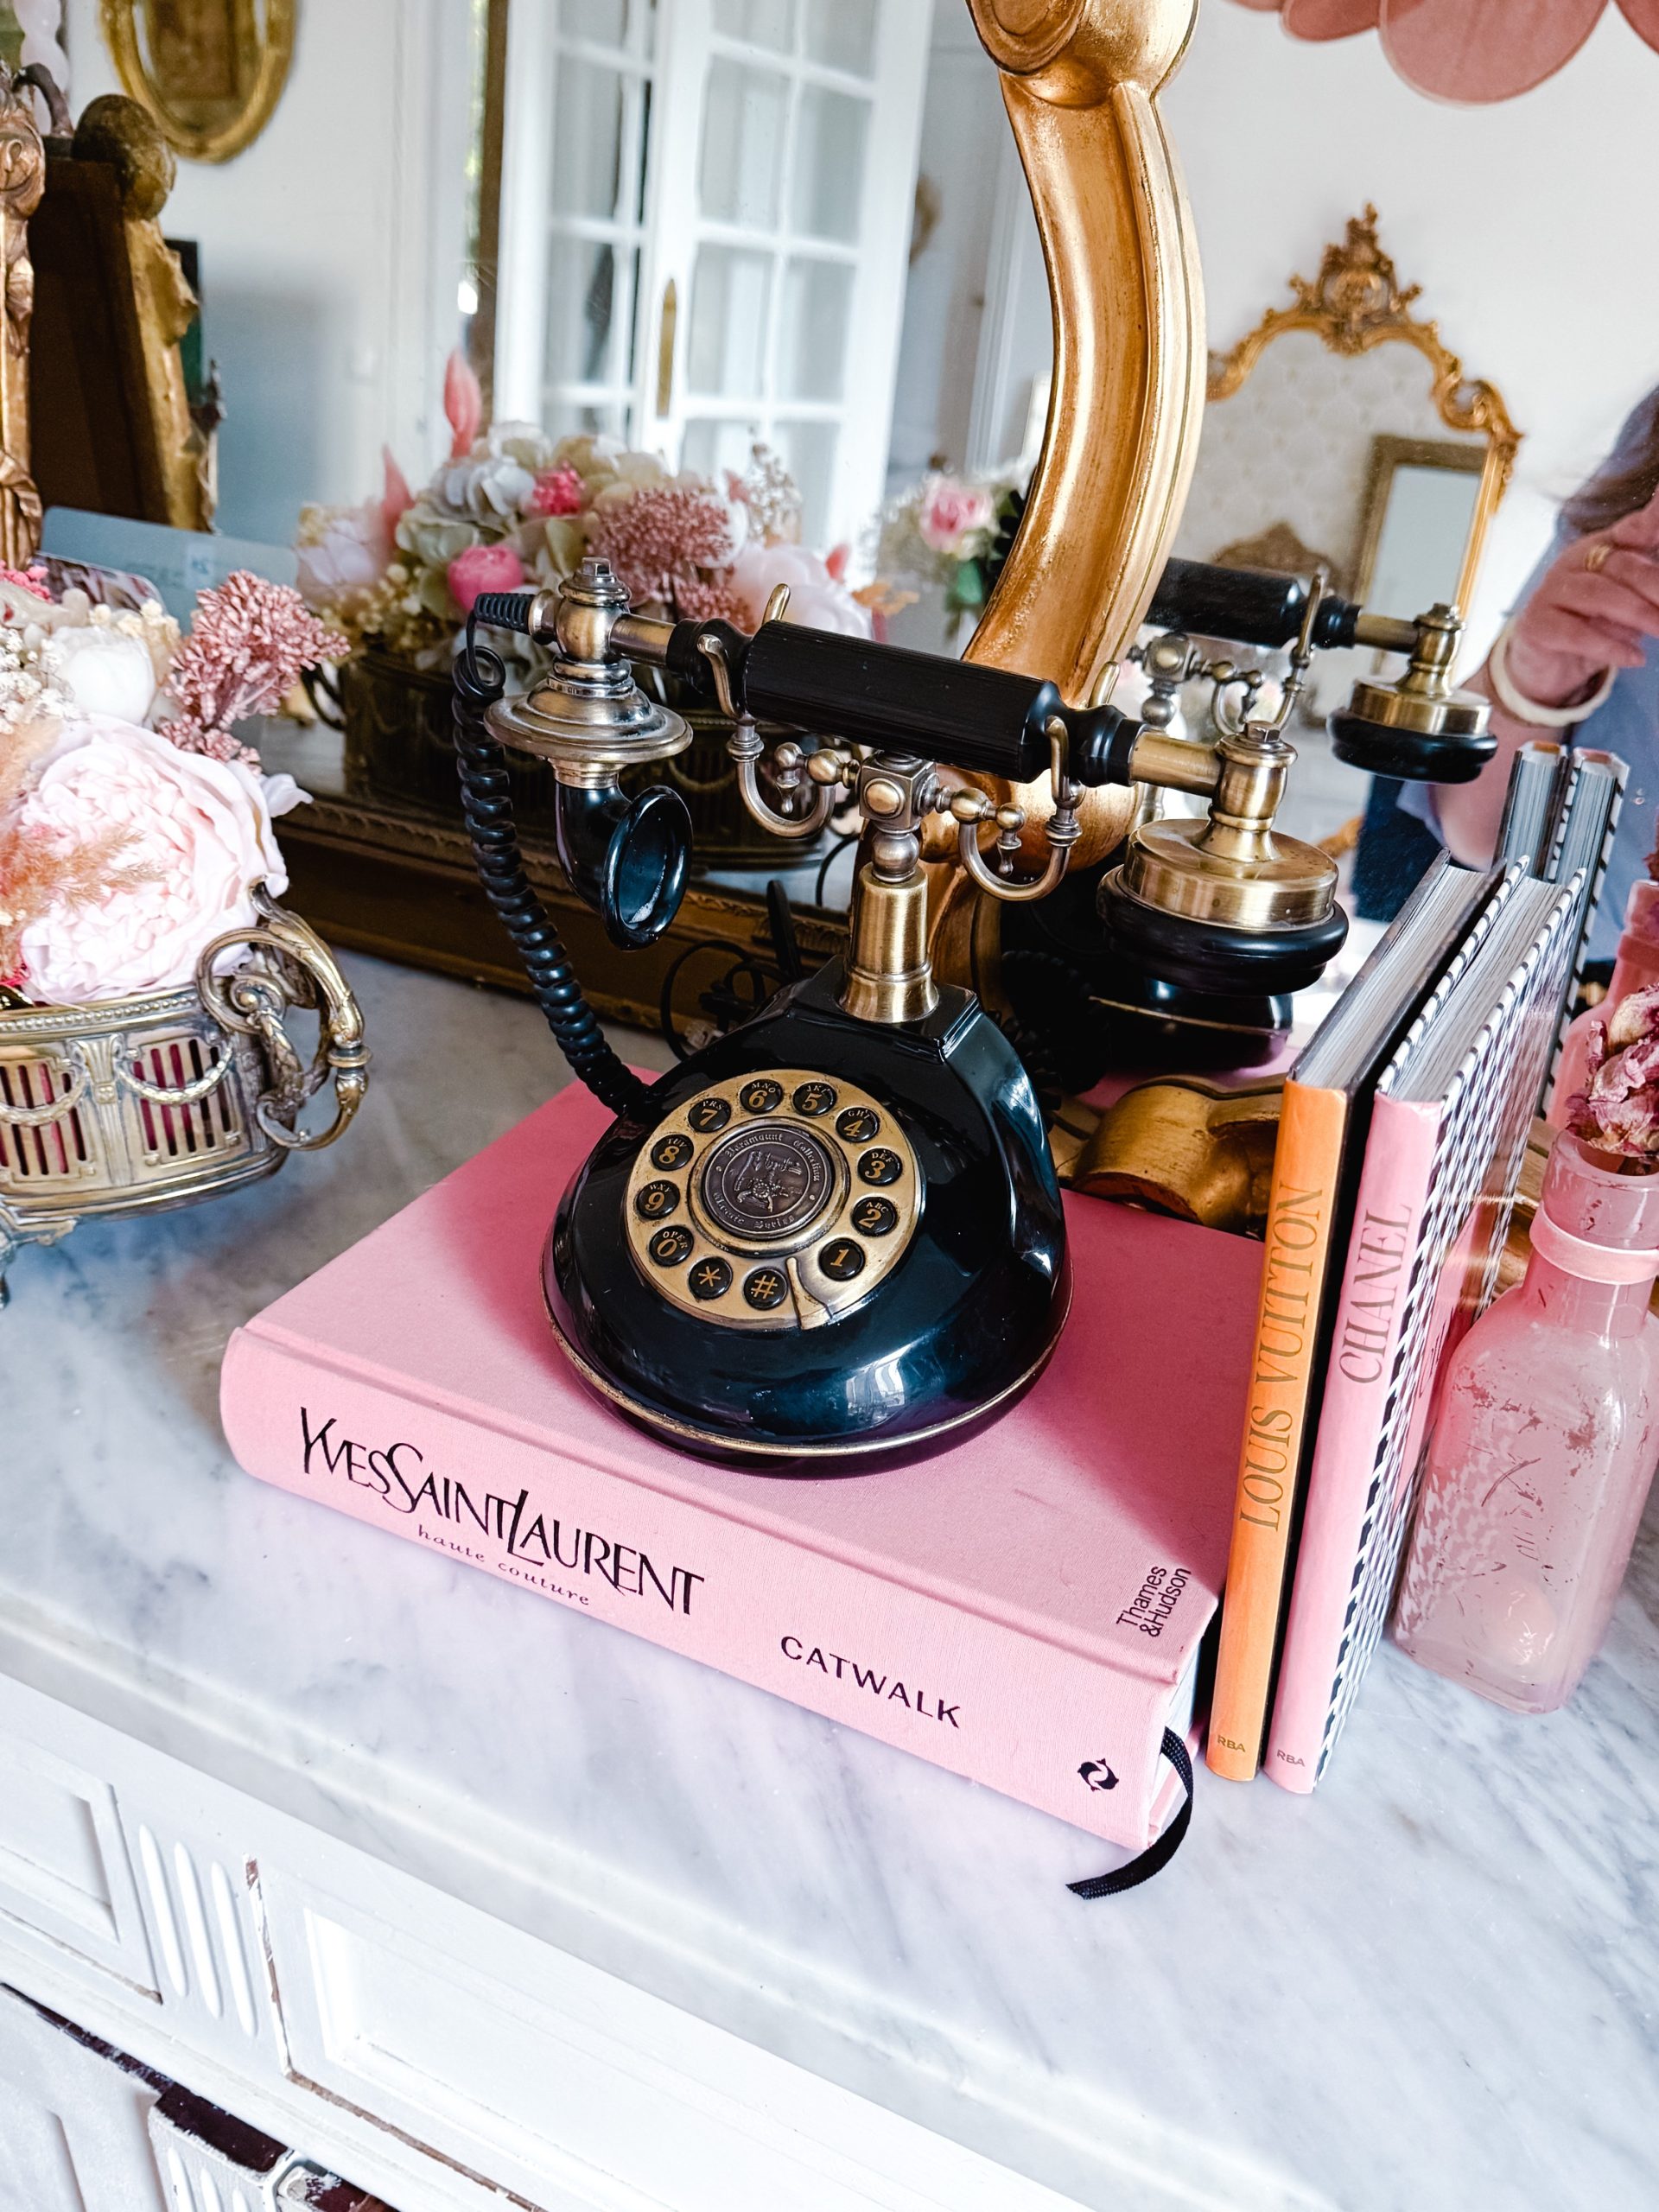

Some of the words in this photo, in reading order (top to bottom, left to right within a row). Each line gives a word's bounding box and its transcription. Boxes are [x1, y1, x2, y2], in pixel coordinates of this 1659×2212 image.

[752, 1082, 776, 1093] MNO
[702, 1100, 724, 1111] PRS
[748, 1090, 768, 1109] 6
[801, 1092, 823, 1111] 5
[699, 1109, 718, 1127] 7
[848, 1109, 871, 1121] GHI
[843, 1120, 864, 1138] 4
[666, 1138, 688, 1148] TUV
[658, 1145, 680, 1165] 8
[871, 1152, 893, 1163] DEF
[864, 1160, 886, 1179] 3
[649, 1183, 672, 1193] WXY
[645, 1192, 664, 1211] 9
[866, 1201, 889, 1213] ABC
[858, 1209, 881, 1229] 2
[662, 1230, 689, 1249] OPER
[830, 1249, 849, 1267] 1
[1255, 1180, 1323, 1384] VUITTON
[1338, 1205, 1414, 1384] CHANEL
[1240, 1405, 1294, 1532] LOUIS
[417, 1523, 486, 1563] haute
[498, 1562, 589, 1606] couture
[1116, 1566, 1167, 1626] Thames
[1140, 1567, 1192, 1637] &Hudson
[780, 1635, 962, 1729] CATWALK
[1217, 1734, 1246, 1753] RBA
[1276, 1749, 1306, 1768] RBA
